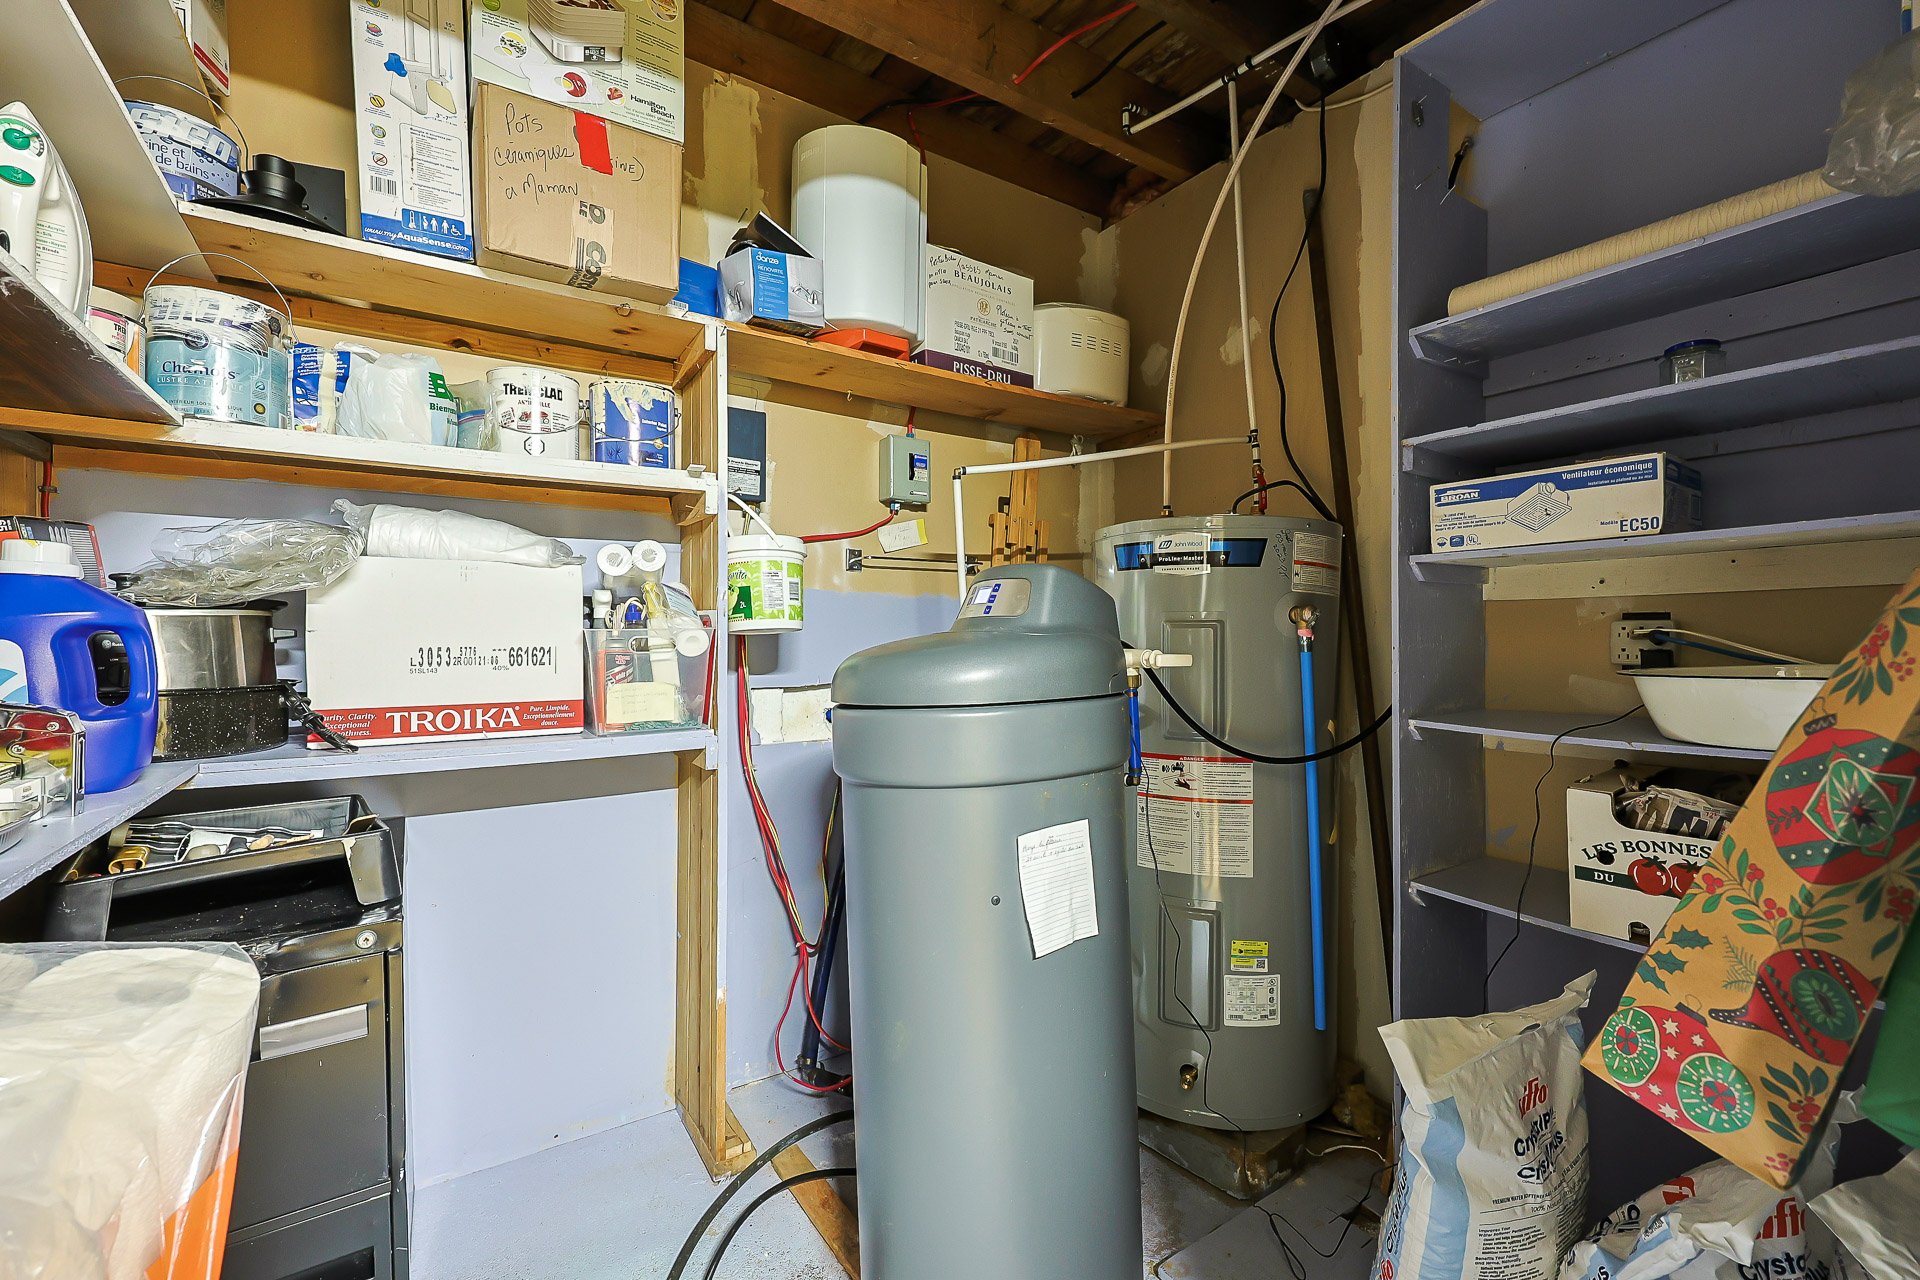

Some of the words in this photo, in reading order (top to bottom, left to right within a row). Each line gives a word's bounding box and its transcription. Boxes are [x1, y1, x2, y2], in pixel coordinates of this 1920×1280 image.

[630, 94, 666, 112] Hamilton
[504, 102, 544, 136] Pots
[650, 106, 675, 120] Beach
[172, 145, 186, 160] et
[155, 152, 172, 167] de
[176, 158, 210, 181] bains
[954, 269, 1012, 295] BEAUJOLAIS
[953, 361, 1011, 385] PISSE-DRU
[1562, 468, 1603, 480] Ventilateur
[1604, 461, 1653, 475] économique
[1440, 491, 1479, 502] BROAN
[1619, 516, 1660, 533] EC50
[459, 646, 477, 657] 5776
[508, 646, 552, 667] 661621
[522, 711, 576, 721] Exceptionnellement
[529, 705, 545, 713] Pure.
[545, 704, 570, 713] Limpide.
[322, 714, 345, 722] urity.
[347, 713, 377, 721] Clarity.
[385, 705, 522, 735] TROIKA
[540, 718, 559, 726] douce.
[1620, 839, 1713, 860] BONNES
[1593, 871, 1615, 883] DU
